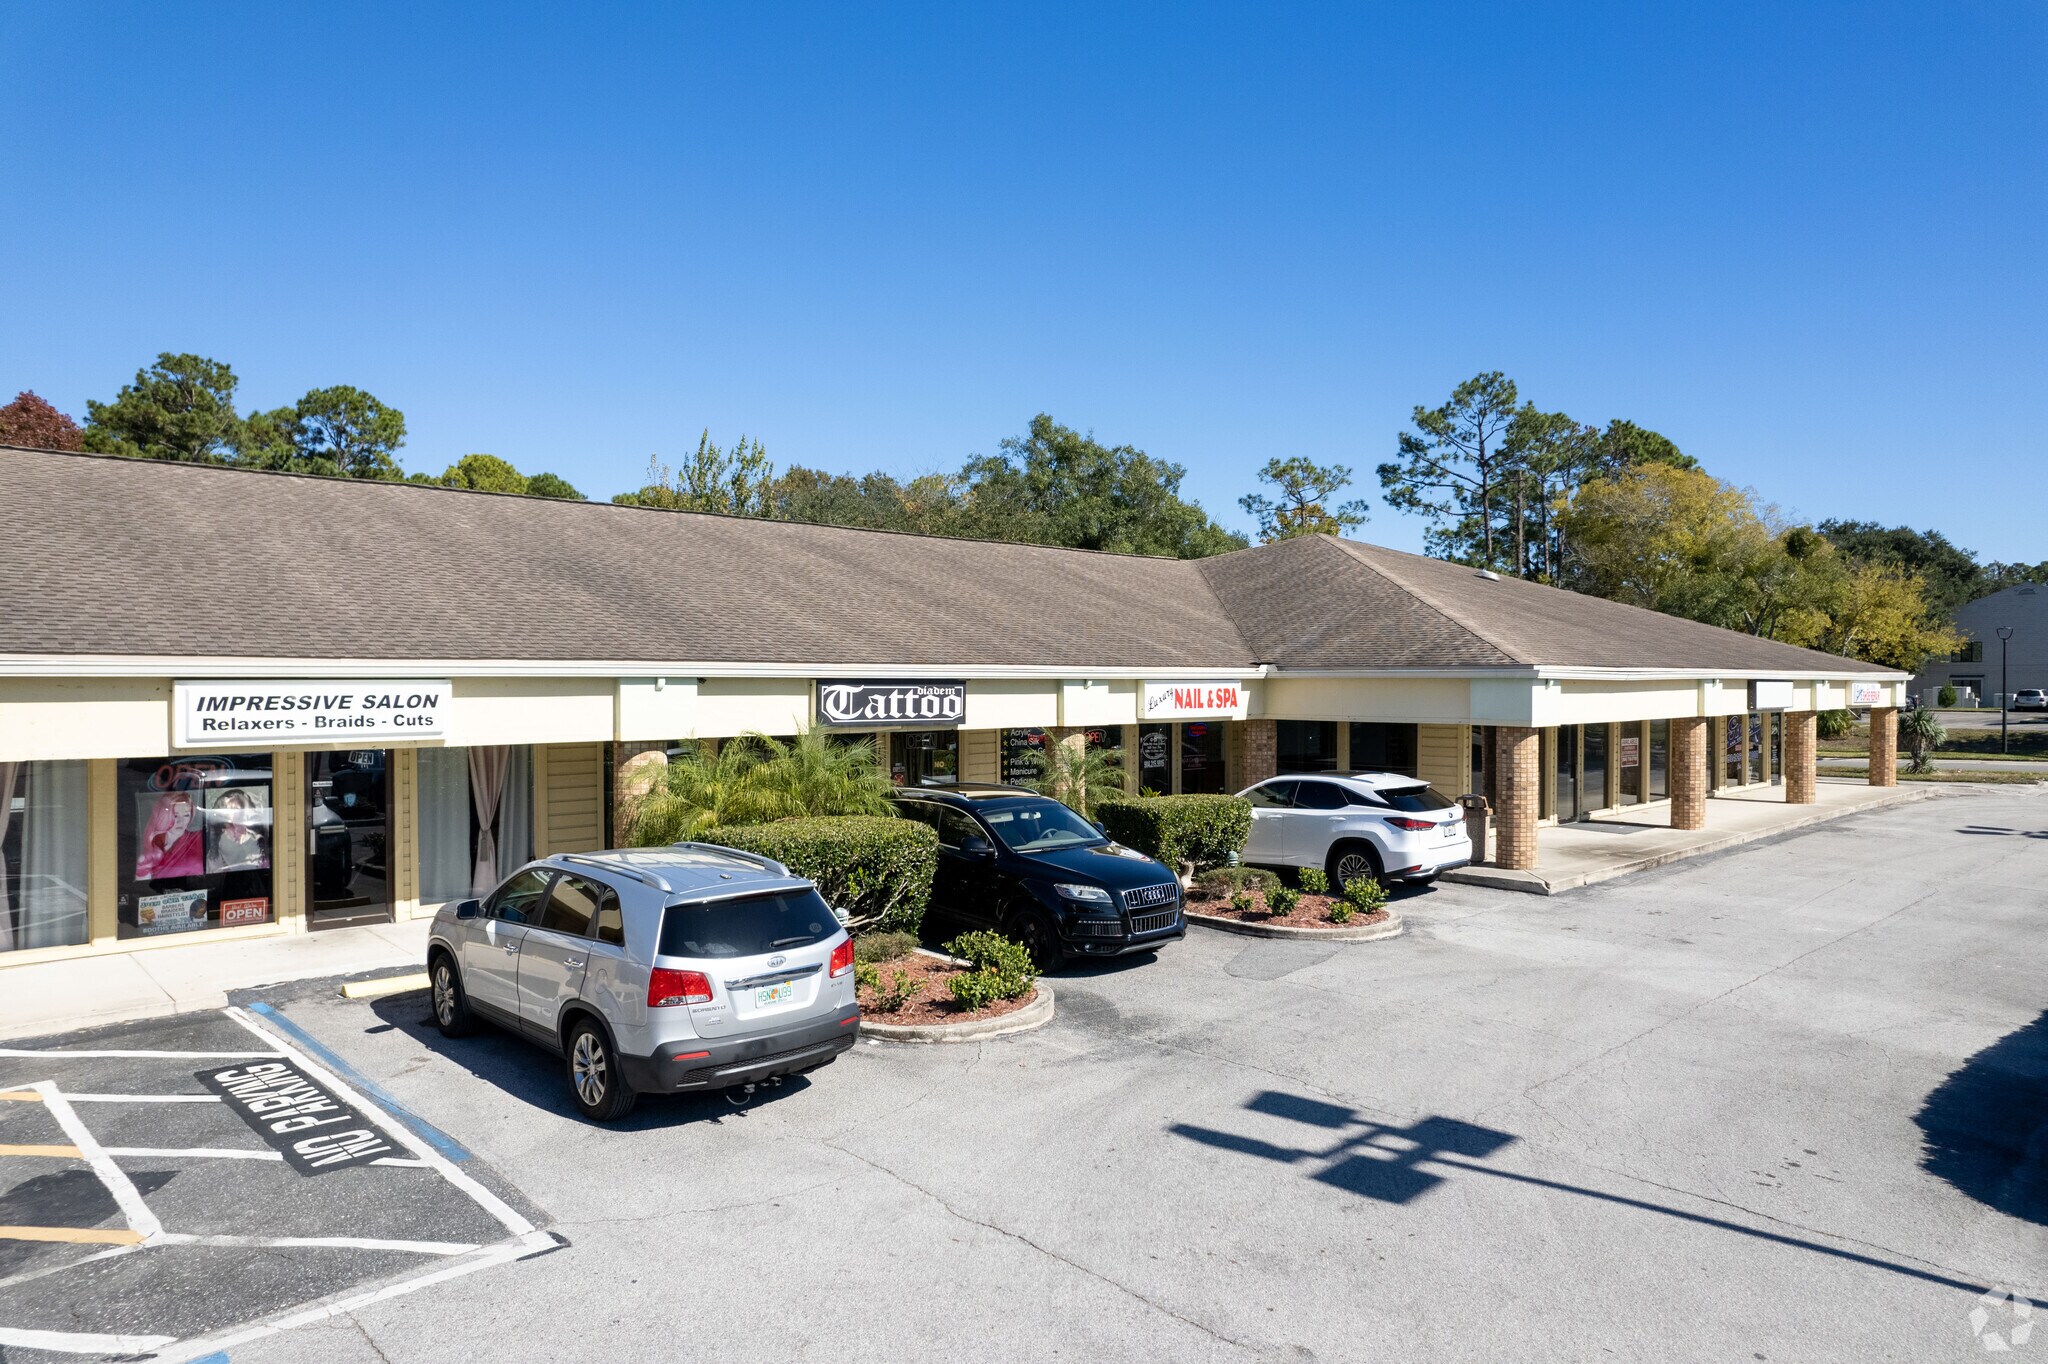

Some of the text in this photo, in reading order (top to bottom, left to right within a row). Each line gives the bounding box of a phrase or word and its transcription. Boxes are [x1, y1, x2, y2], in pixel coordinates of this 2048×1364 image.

[917, 686, 956, 696] diadem
[196, 694, 439, 712] IMPRESSIVE SALON
[823, 684, 962, 720] Tattoo
[1147, 687, 1238, 712] Luxury NAIL & SPA
[202, 717, 295, 731] Relaxers
[314, 714, 375, 729] Braids
[393, 713, 434, 727] Cuts
[1010, 738, 1028, 747] China
[1085, 731, 1106, 743] OPEN
[349, 752, 374, 765] OPEN
[1010, 758, 1023, 766] Pink
[1025, 758, 1030, 766] &
[1010, 768, 1038, 776] Manicure
[157, 911, 188, 919] HAIRSTYLIST
[226, 907, 262, 920] OPEN
[143, 925, 169, 933] BOOTHS
[170, 922, 203, 931] AVAILABLE
[771, 959, 784, 967] KIA
[758, 990, 771, 1003] HSN
[692, 1005, 726, 1014] SORENTO
[214, 1063, 392, 1168] NO PARKING
